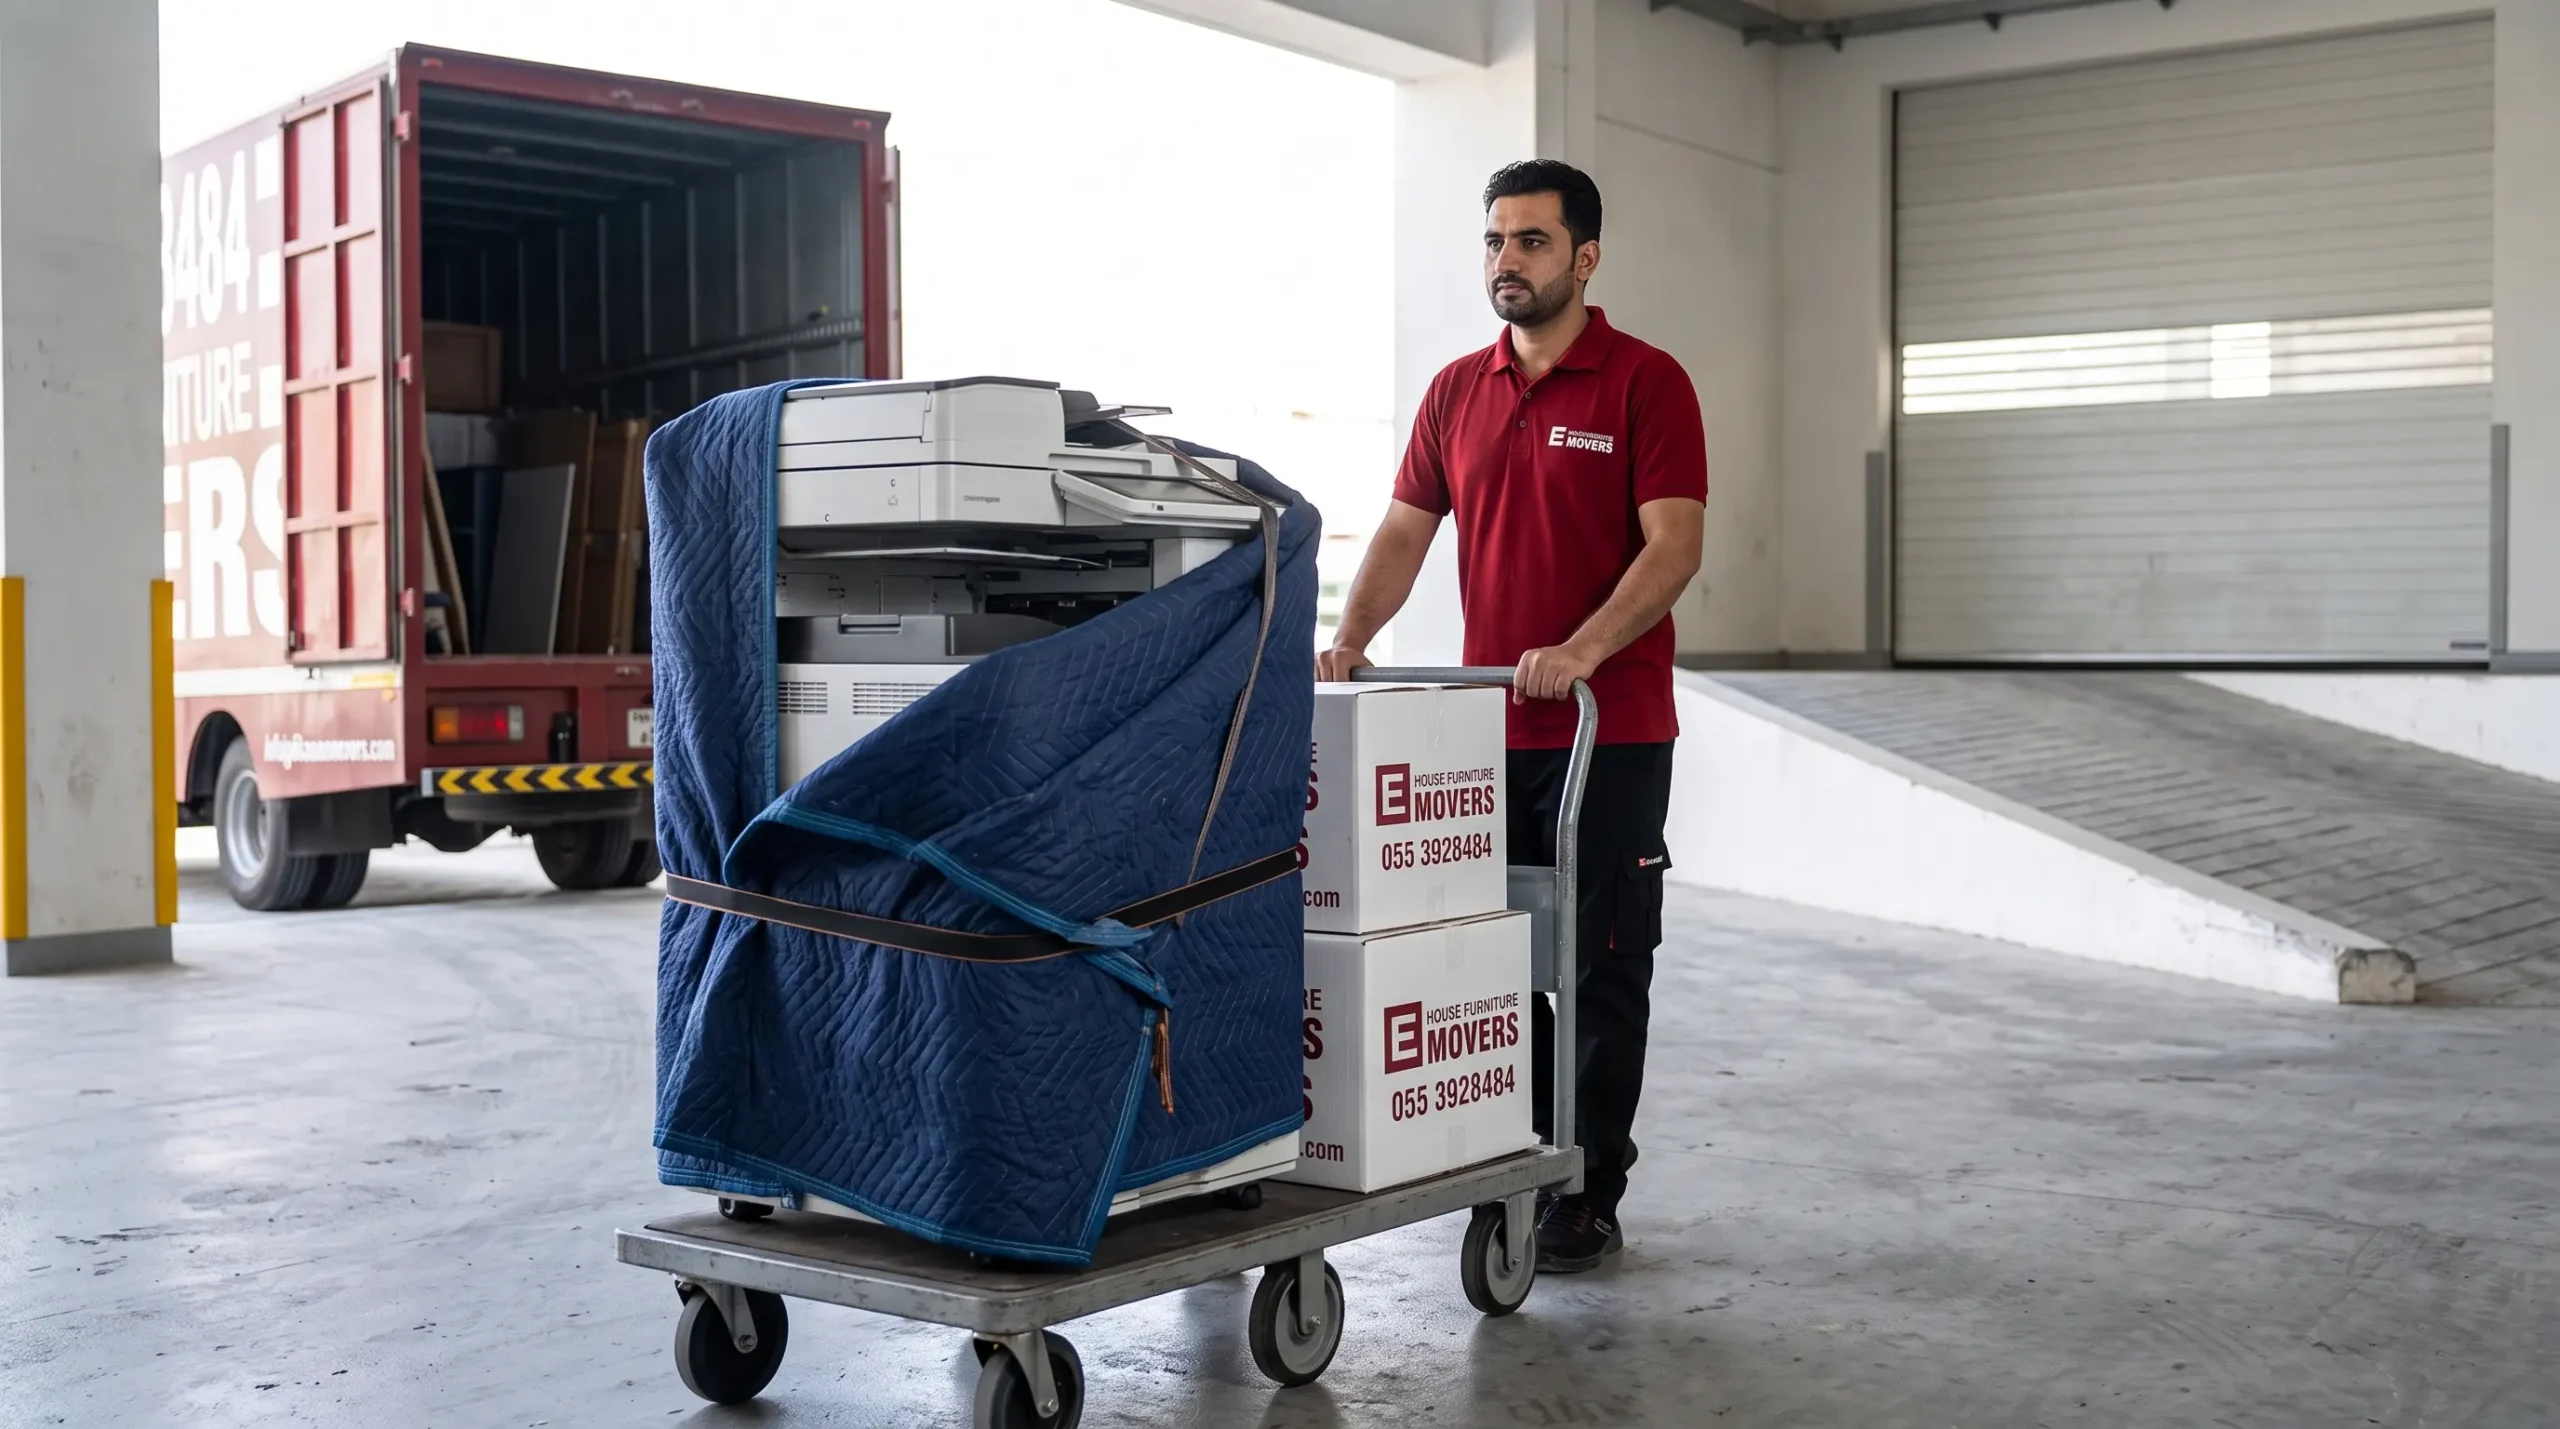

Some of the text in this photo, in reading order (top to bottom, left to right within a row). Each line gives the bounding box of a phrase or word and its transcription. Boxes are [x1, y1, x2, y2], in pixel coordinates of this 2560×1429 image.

[1548, 426, 1567, 447] E
[1566, 436, 1613, 454] MOVERS
[1381, 772, 1407, 817] E
[1414, 767, 1495, 788] HOUSE FURNITURE
[1414, 784, 1495, 822] MOVERS
[1381, 831, 1493, 871] 055 3928484
[1426, 992, 1519, 1025] HOUSE FURNITURE
[1391, 1012, 1419, 1063] E
[1427, 1011, 1519, 1064] MOVERS
[1391, 1063, 1516, 1122] 055 3928484
[1300, 1140, 1344, 1163] .com
